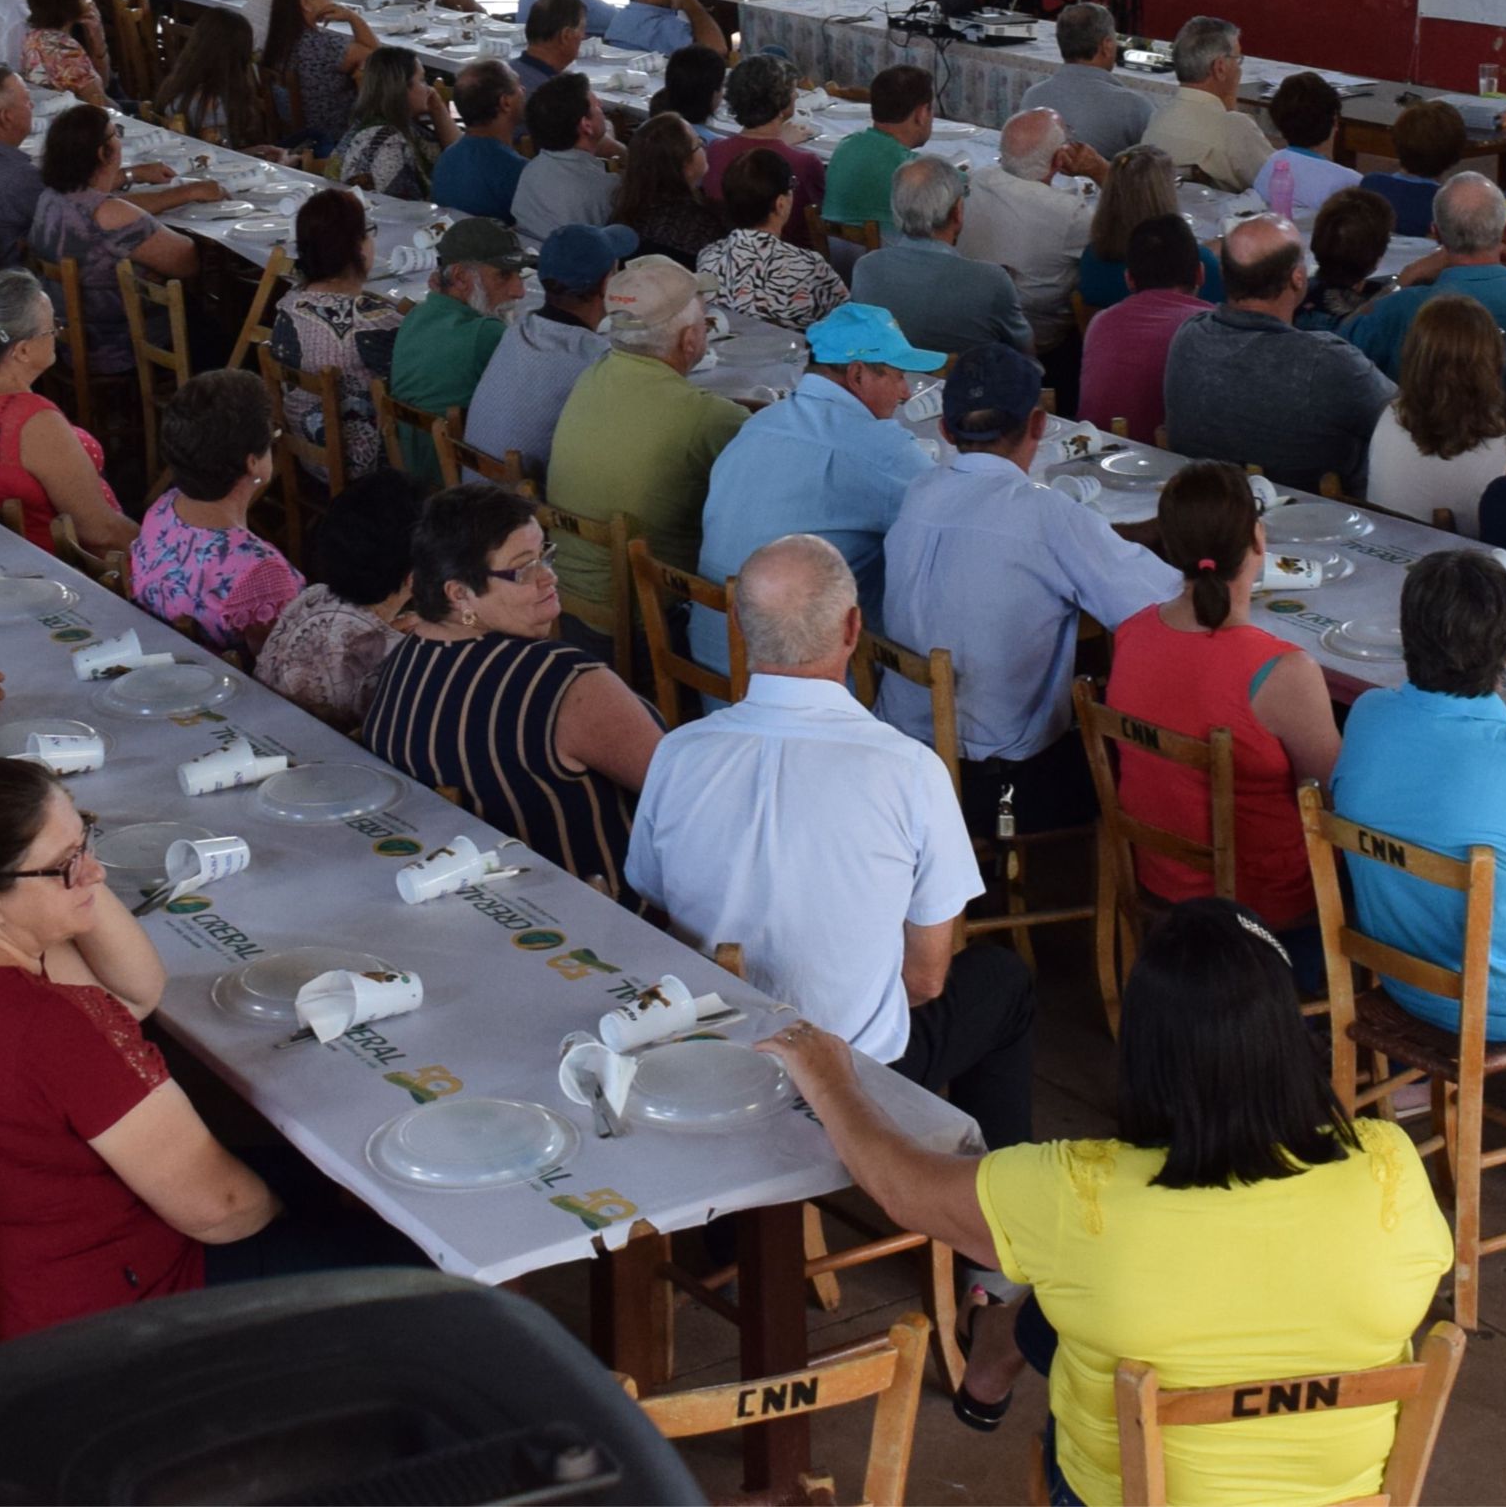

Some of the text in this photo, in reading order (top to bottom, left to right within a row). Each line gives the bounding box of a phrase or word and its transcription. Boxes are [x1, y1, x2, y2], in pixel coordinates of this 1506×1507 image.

[1121, 717, 1160, 749] CNN
[1359, 830, 1407, 867] CNN
[192, 913, 265, 961] CRERAL
[737, 1377, 819, 1419] CNN
[1232, 1376, 1340, 1418] CNN
